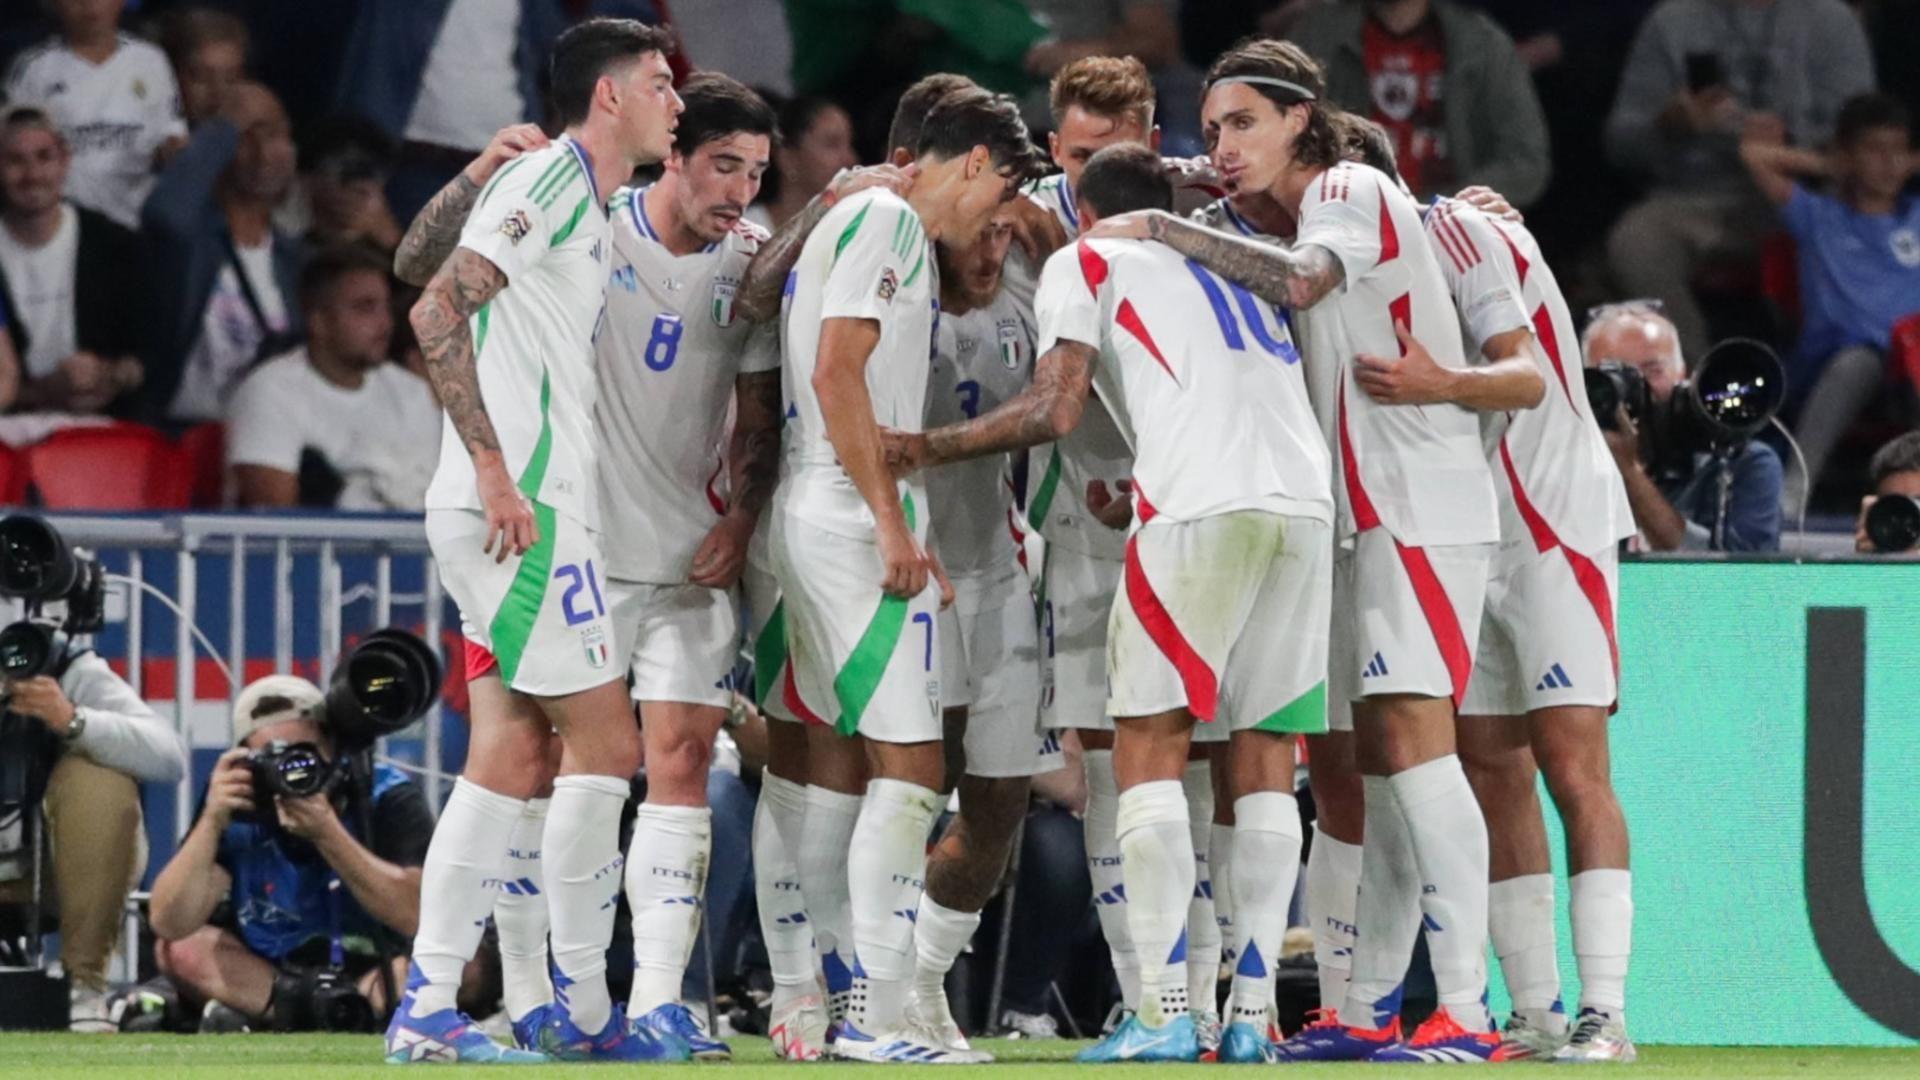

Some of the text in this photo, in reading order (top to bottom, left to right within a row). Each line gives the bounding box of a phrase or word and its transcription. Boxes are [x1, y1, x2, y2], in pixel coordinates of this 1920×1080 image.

[644, 312, 684, 372] 8
[554, 558, 605, 626] 21
[912, 611, 933, 672] 7
